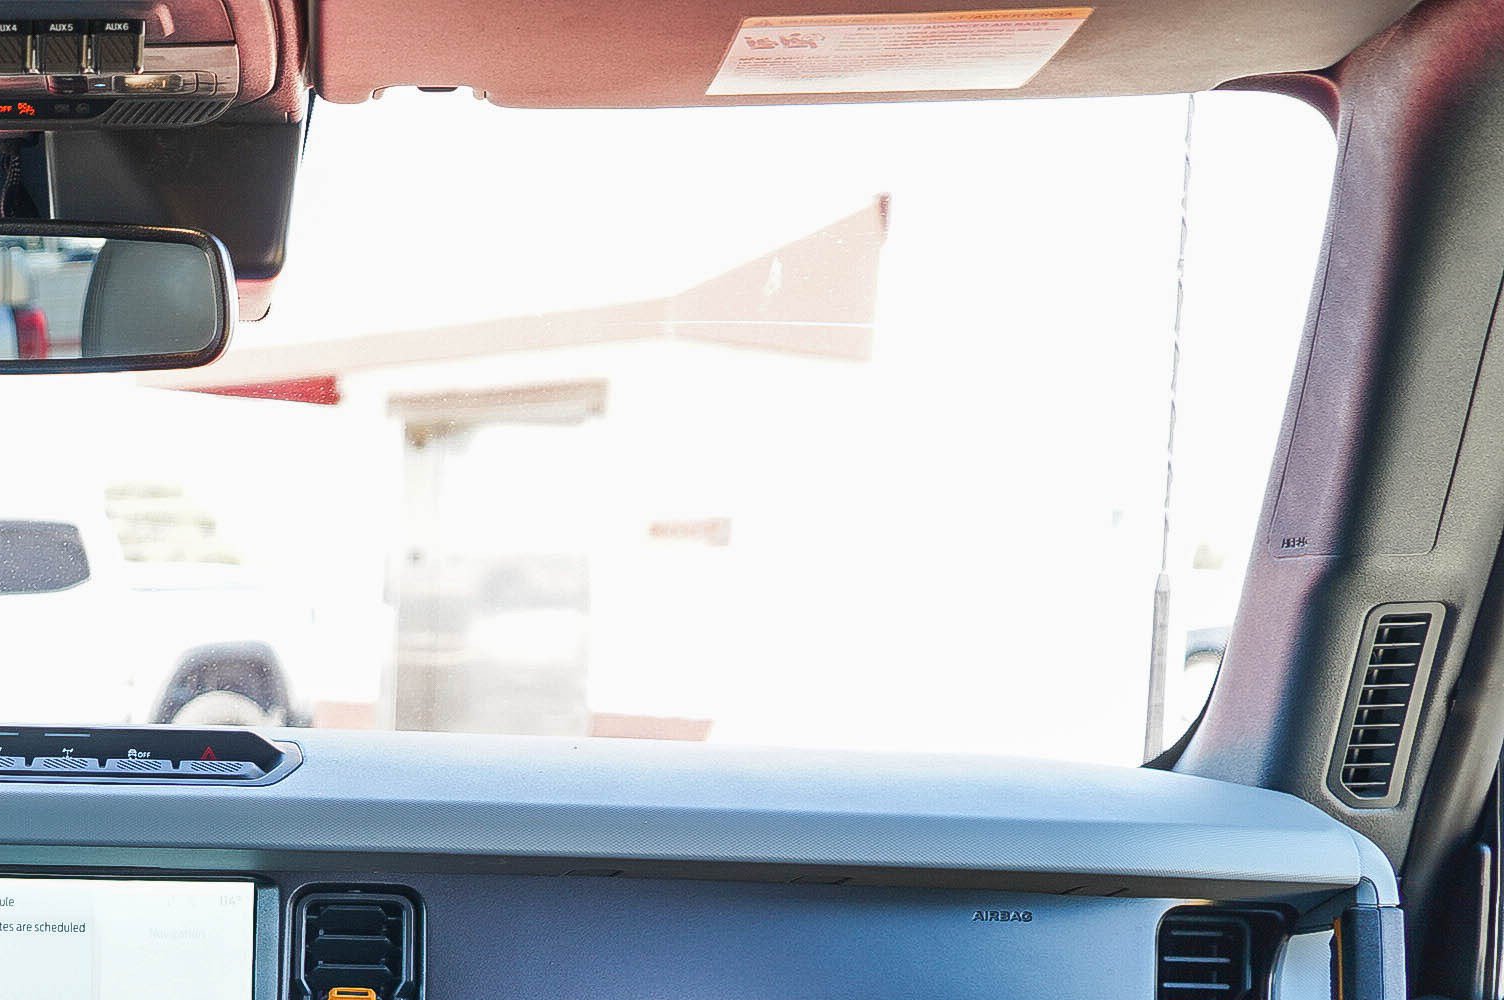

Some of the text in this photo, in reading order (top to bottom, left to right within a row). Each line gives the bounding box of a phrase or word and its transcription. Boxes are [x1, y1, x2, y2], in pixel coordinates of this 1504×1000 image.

[972, 909, 1033, 923] AIRBAG
[16, 924, 33, 933] are
[34, 922, 86, 934] scheduled
